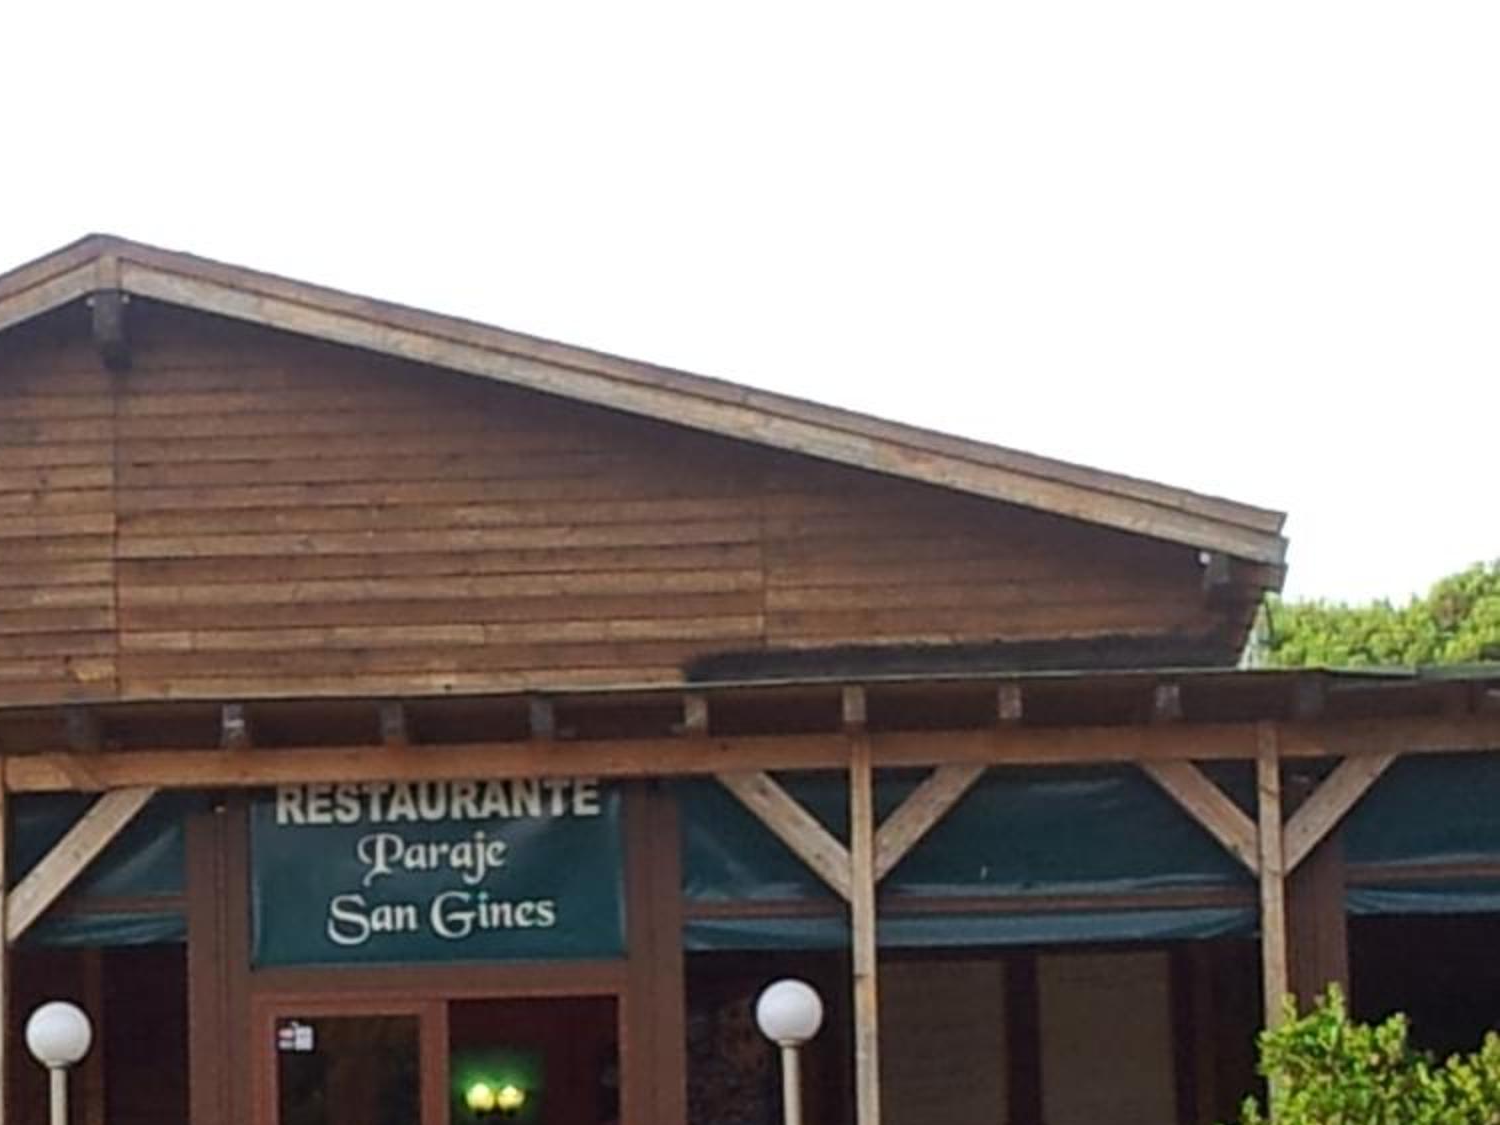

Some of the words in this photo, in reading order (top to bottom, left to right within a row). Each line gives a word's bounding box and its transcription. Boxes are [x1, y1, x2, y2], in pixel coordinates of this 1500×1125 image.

[276, 780, 600, 824] RESTAURANTE
[357, 831, 505, 887] Paraje
[327, 894, 418, 945] San
[430, 890, 556, 939] Gines
